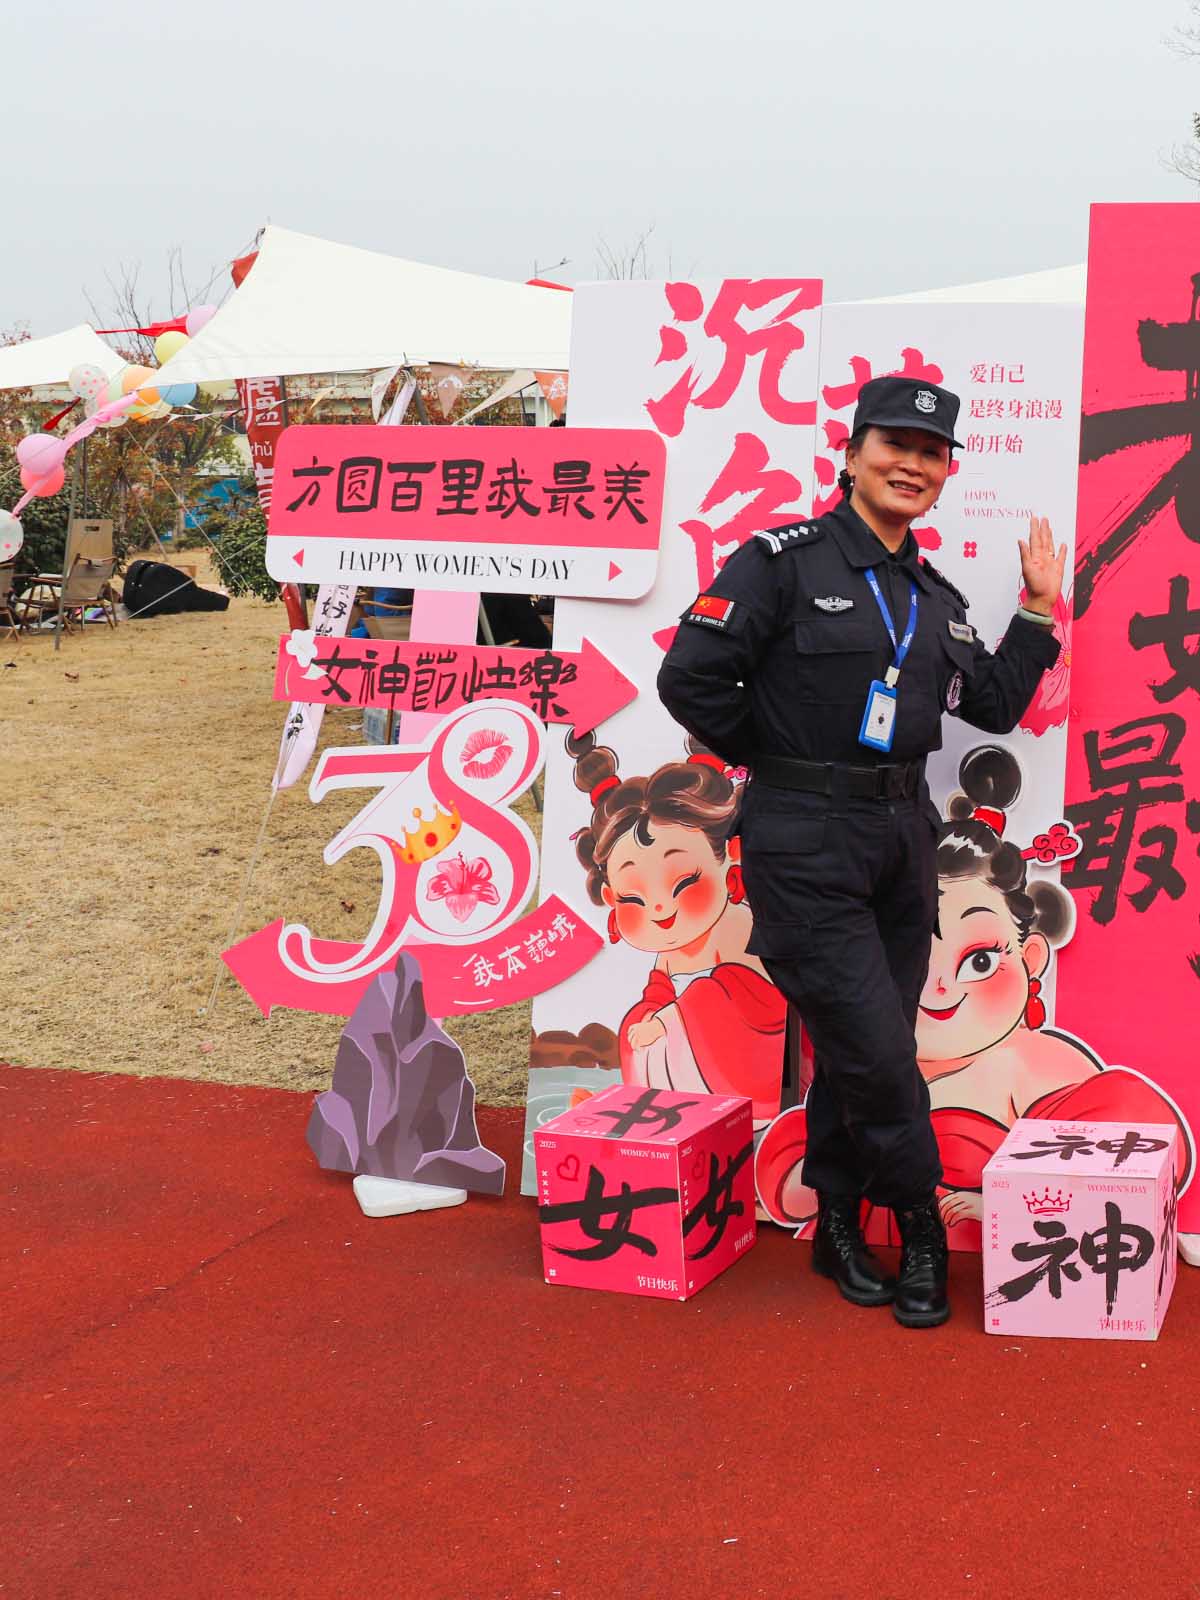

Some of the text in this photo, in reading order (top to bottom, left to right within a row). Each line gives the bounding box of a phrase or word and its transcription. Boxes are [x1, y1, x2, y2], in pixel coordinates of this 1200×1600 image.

[970, 363, 1025, 383] 爱自己
[968, 399, 1063, 420] 是终身浪漫
[966, 433, 1023, 454] 的开始
[286, 455, 651, 525] 方圆百里我最美
[964, 490, 998, 502] HAPPY
[963, 507, 1012, 519] WOMEN'S
[338, 550, 575, 580] HAPPY WOMEN'S DAY
[593, 1088, 700, 1138] 女
[1009, 1131, 1170, 1167] 神
[539, 1164, 680, 1261] 女
[683, 1141, 754, 1261] 女
[985, 1201, 1156, 1318] 神
[637, 1275, 679, 1292] 节日快乐
